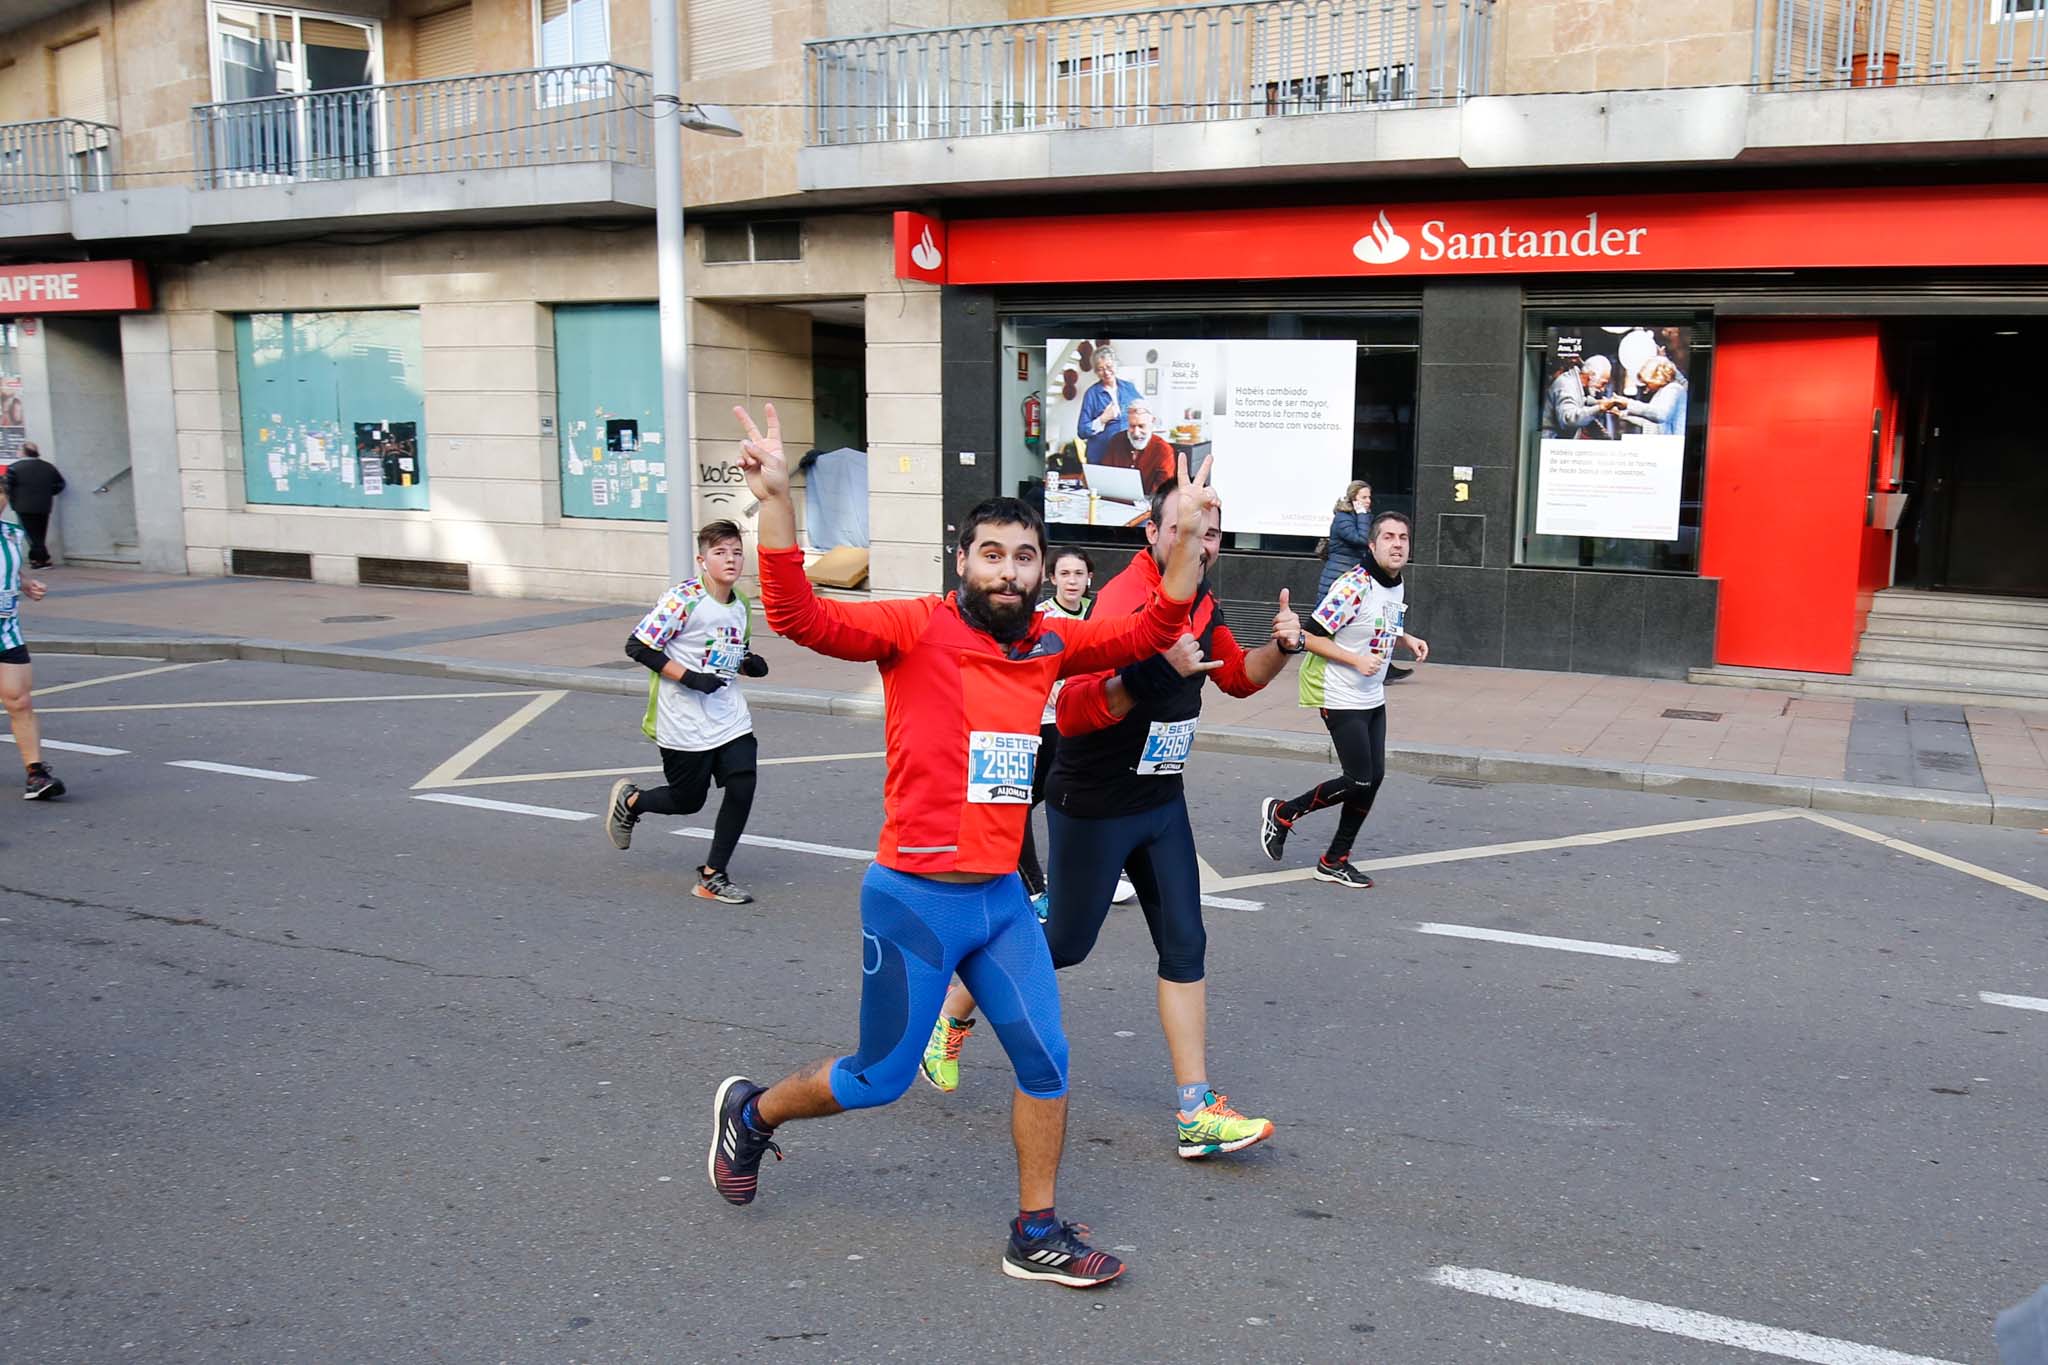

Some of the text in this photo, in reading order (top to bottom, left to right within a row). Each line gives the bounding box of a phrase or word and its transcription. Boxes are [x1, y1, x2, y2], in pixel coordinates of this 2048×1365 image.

[1420, 212, 1647, 261] Santander
[1266, 387, 1308, 396] cambiado
[1235, 398, 1243, 406] la
[1245, 398, 1270, 406] forma
[1272, 398, 1282, 407] de
[1285, 399, 1298, 407] ser
[1234, 409, 1321, 419] nosotros la forma de
[1234, 420, 1257, 429] hacer
[1259, 420, 1284, 430] banca
[1286, 422, 1301, 430] con
[1152, 735, 1189, 757] 2960
[982, 751, 1029, 780] 2959
